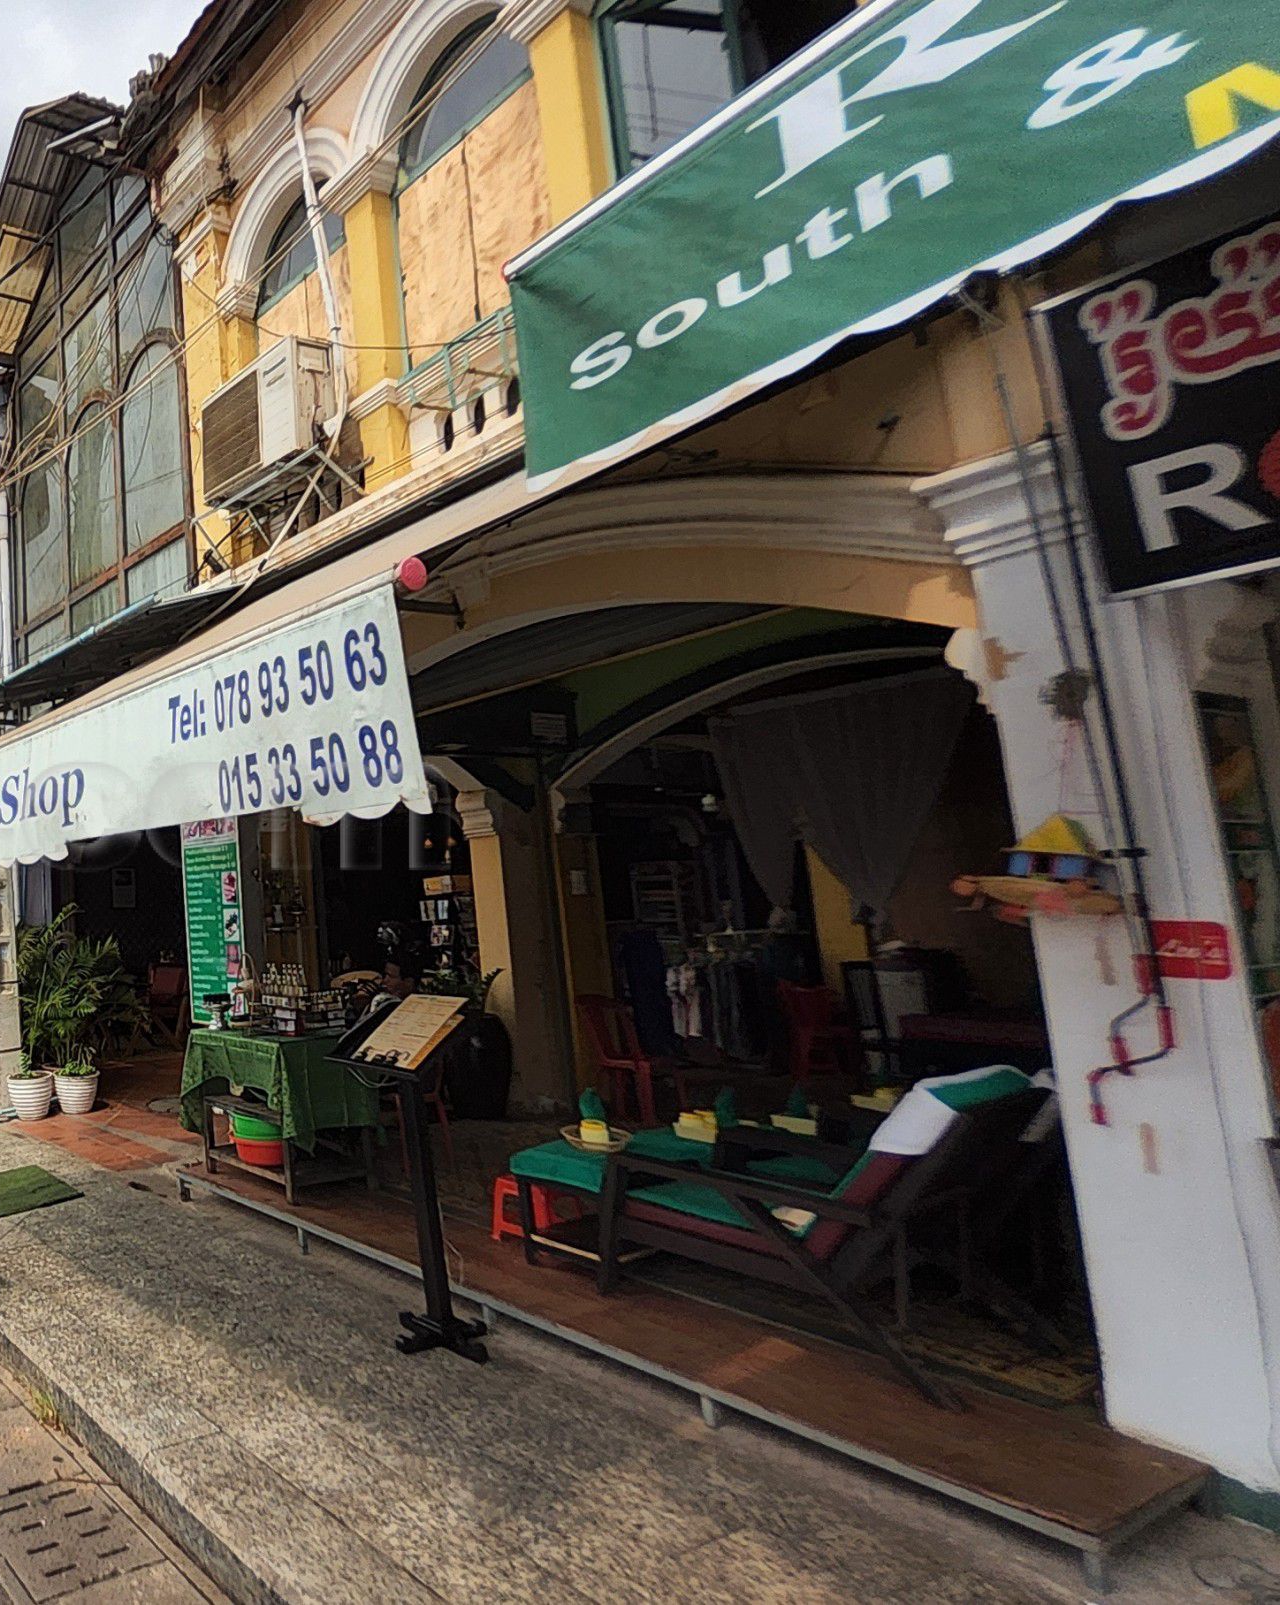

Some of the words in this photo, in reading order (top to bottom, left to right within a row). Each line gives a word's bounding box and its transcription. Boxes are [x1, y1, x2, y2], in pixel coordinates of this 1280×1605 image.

[1126, 430, 1280, 554] R
[168, 689, 207, 744] Tel:
[213, 669, 252, 733] 078
[258, 655, 290, 718] 93
[298, 640, 334, 706] 50
[343, 621, 388, 692] 63
[218, 752, 263, 813] 015
[267, 743, 302, 805] 33
[309, 732, 350, 797] 50
[358, 719, 404, 788] 88
